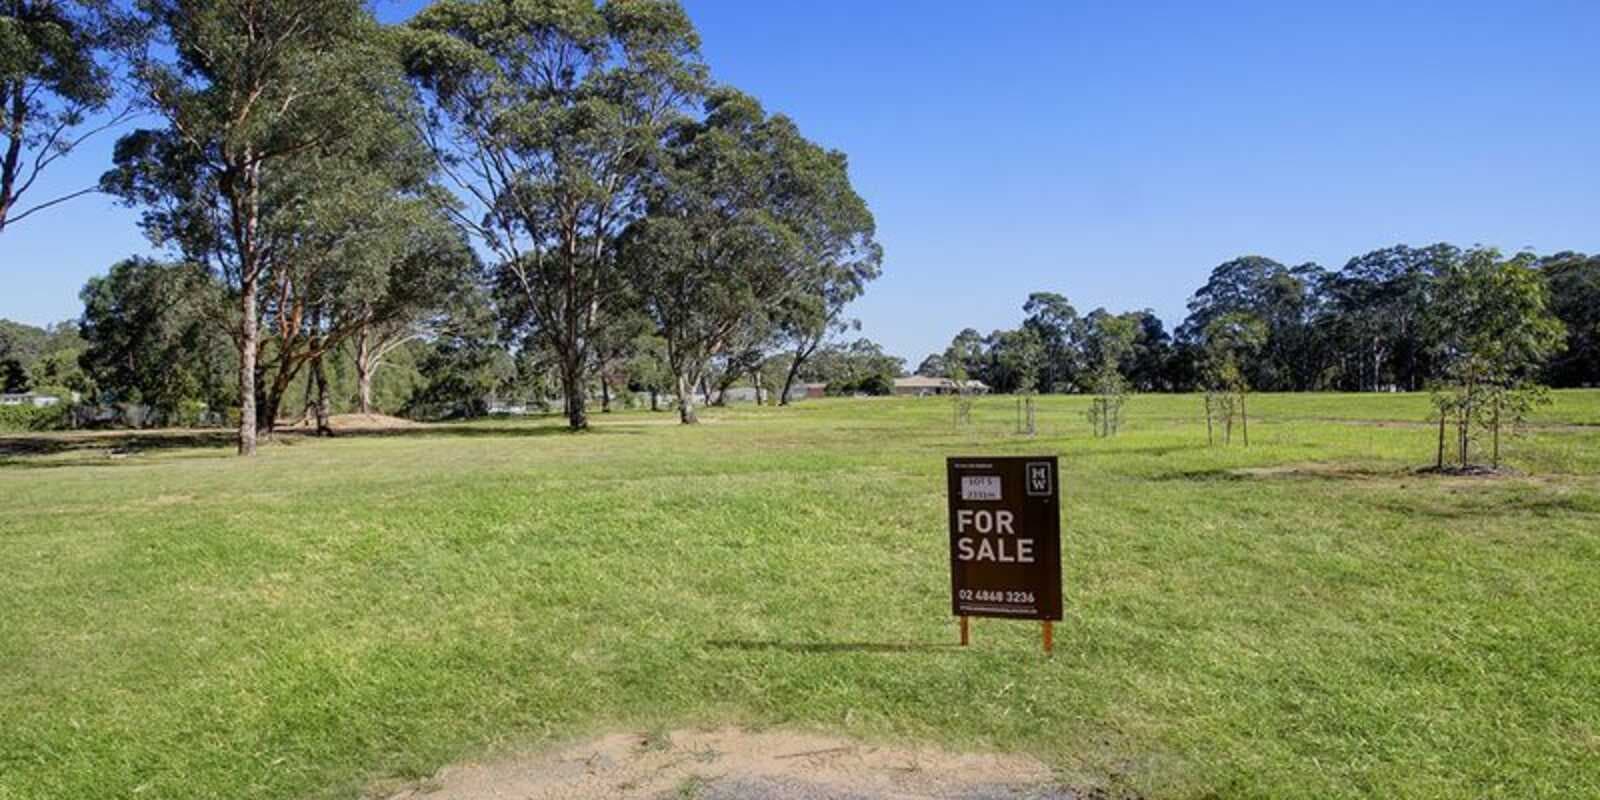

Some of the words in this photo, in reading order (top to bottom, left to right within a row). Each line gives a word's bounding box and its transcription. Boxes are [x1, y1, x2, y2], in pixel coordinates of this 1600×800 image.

[957, 509, 1015, 534] FOR
[958, 537, 1034, 562] SALE
[959, 589, 973, 600] 02
[975, 590, 1004, 602] 4868
[1005, 591, 1035, 603] 3236
